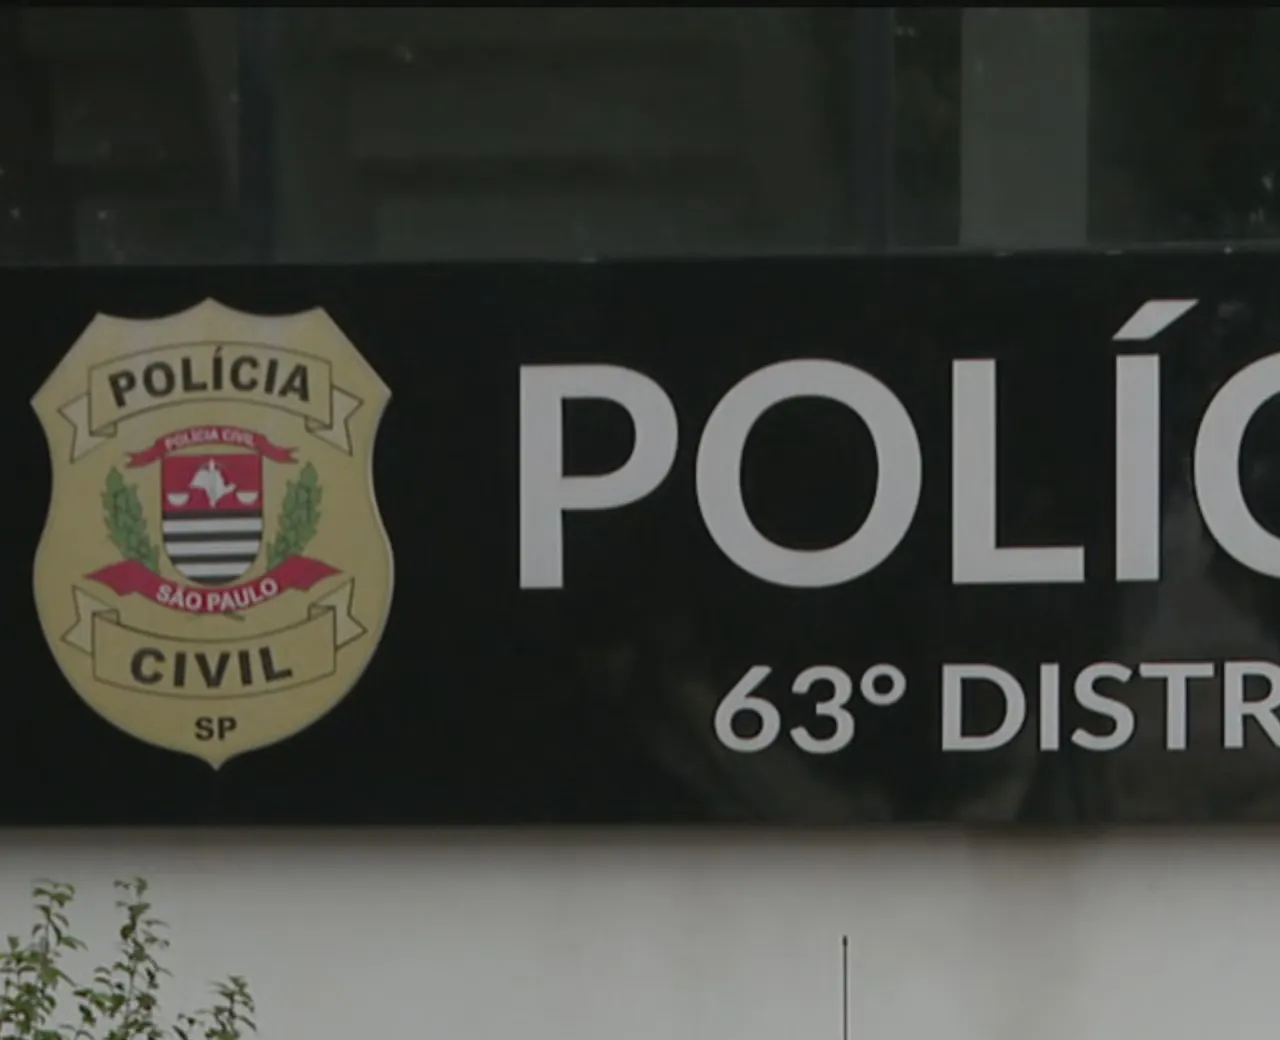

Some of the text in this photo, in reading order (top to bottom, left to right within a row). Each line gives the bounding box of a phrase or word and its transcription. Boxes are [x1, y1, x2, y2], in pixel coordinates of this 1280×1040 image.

[107, 346, 310, 408] POLÍCIA
[206, 577, 278, 611] PAULO
[129, 646, 294, 690] CIVIL
[193, 716, 238, 742] SP
